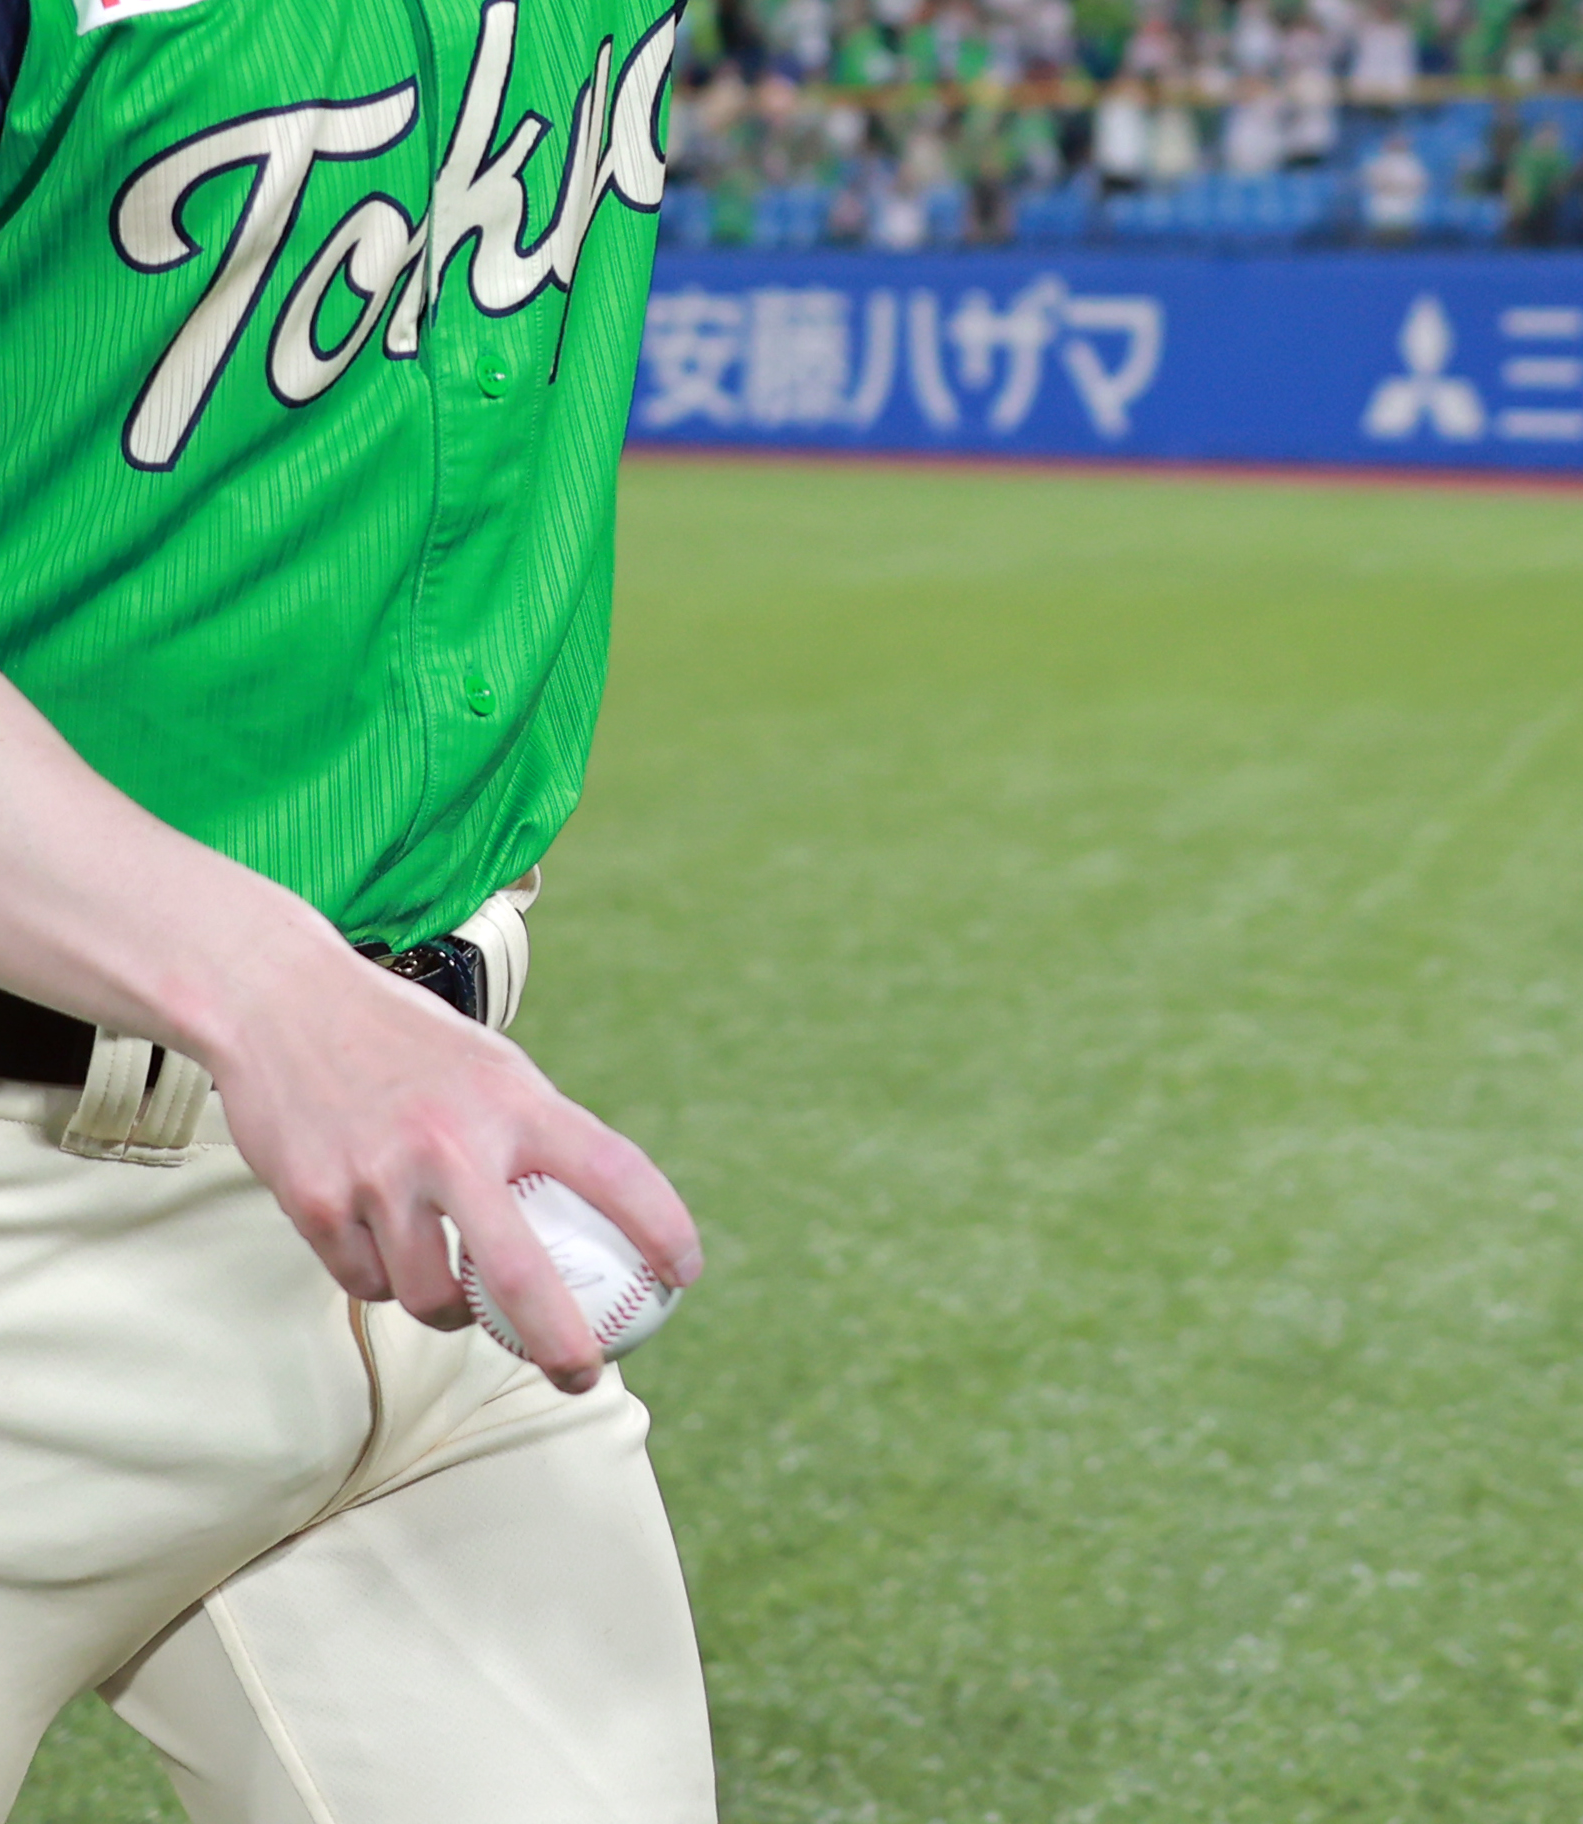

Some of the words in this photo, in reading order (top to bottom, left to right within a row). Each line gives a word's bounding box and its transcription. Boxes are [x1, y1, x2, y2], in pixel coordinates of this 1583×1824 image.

[646, 273, 1162, 440] 安藤ハザマ
